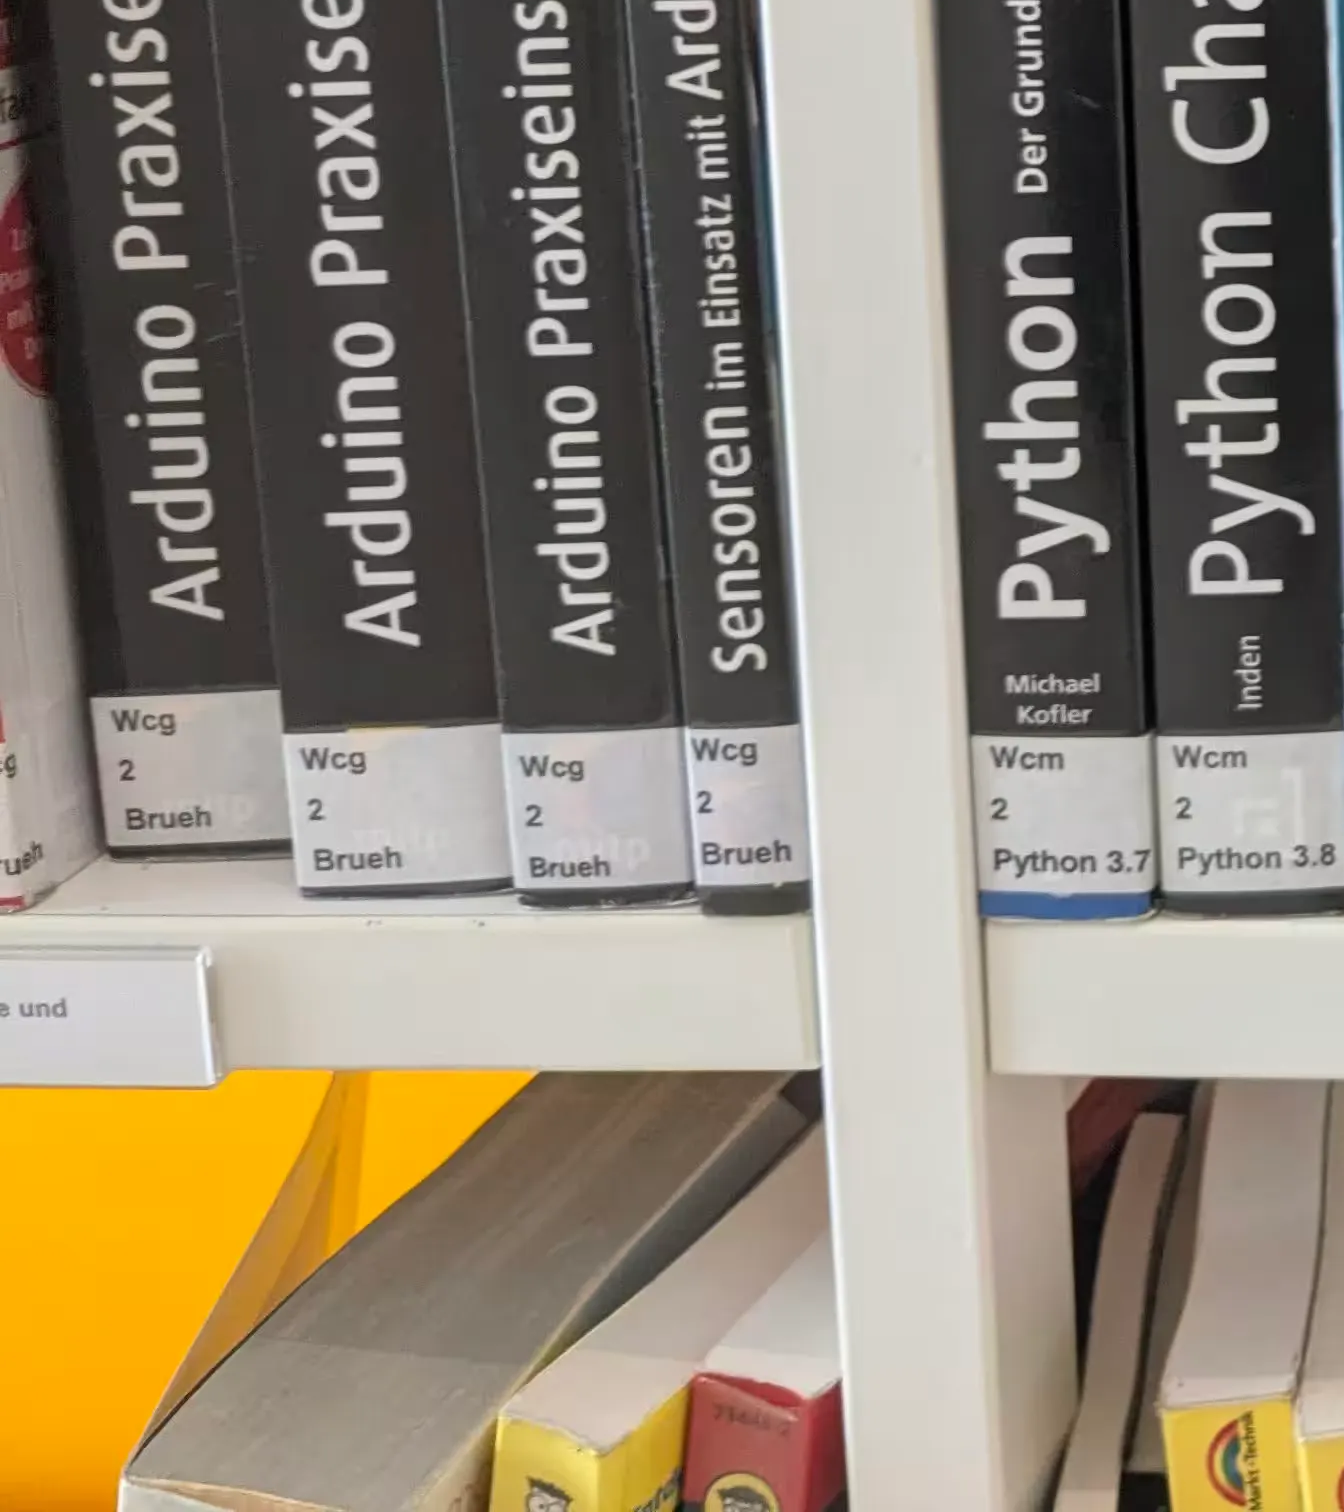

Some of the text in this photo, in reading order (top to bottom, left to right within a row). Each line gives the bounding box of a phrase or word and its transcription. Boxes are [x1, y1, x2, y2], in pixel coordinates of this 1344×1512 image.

[684, 113, 730, 180] mit
[1013, 126, 1049, 194] Der
[694, 192, 741, 328] Einsatz
[705, 341, 747, 390] im
[982, 233, 1111, 620] Python
[1174, 210, 1316, 596] Python
[125, 304, 224, 621] Arduino
[320, 321, 421, 648] Arduino
[533, 385, 617, 656] Arduino
[700, 406, 767, 673] Sensoren
[1005, 674, 1100, 695] Michael
[1234, 634, 1263, 712] Inden
[112, 708, 177, 736] Wcg
[1016, 703, 1093, 726] Kofler
[125, 805, 213, 831] Brueh
[700, 841, 793, 868] Brueh
[992, 847, 1151, 877] Python 3.7
[1177, 842, 1336, 874] Python 3.8
[19, 998, 68, 1018] und
